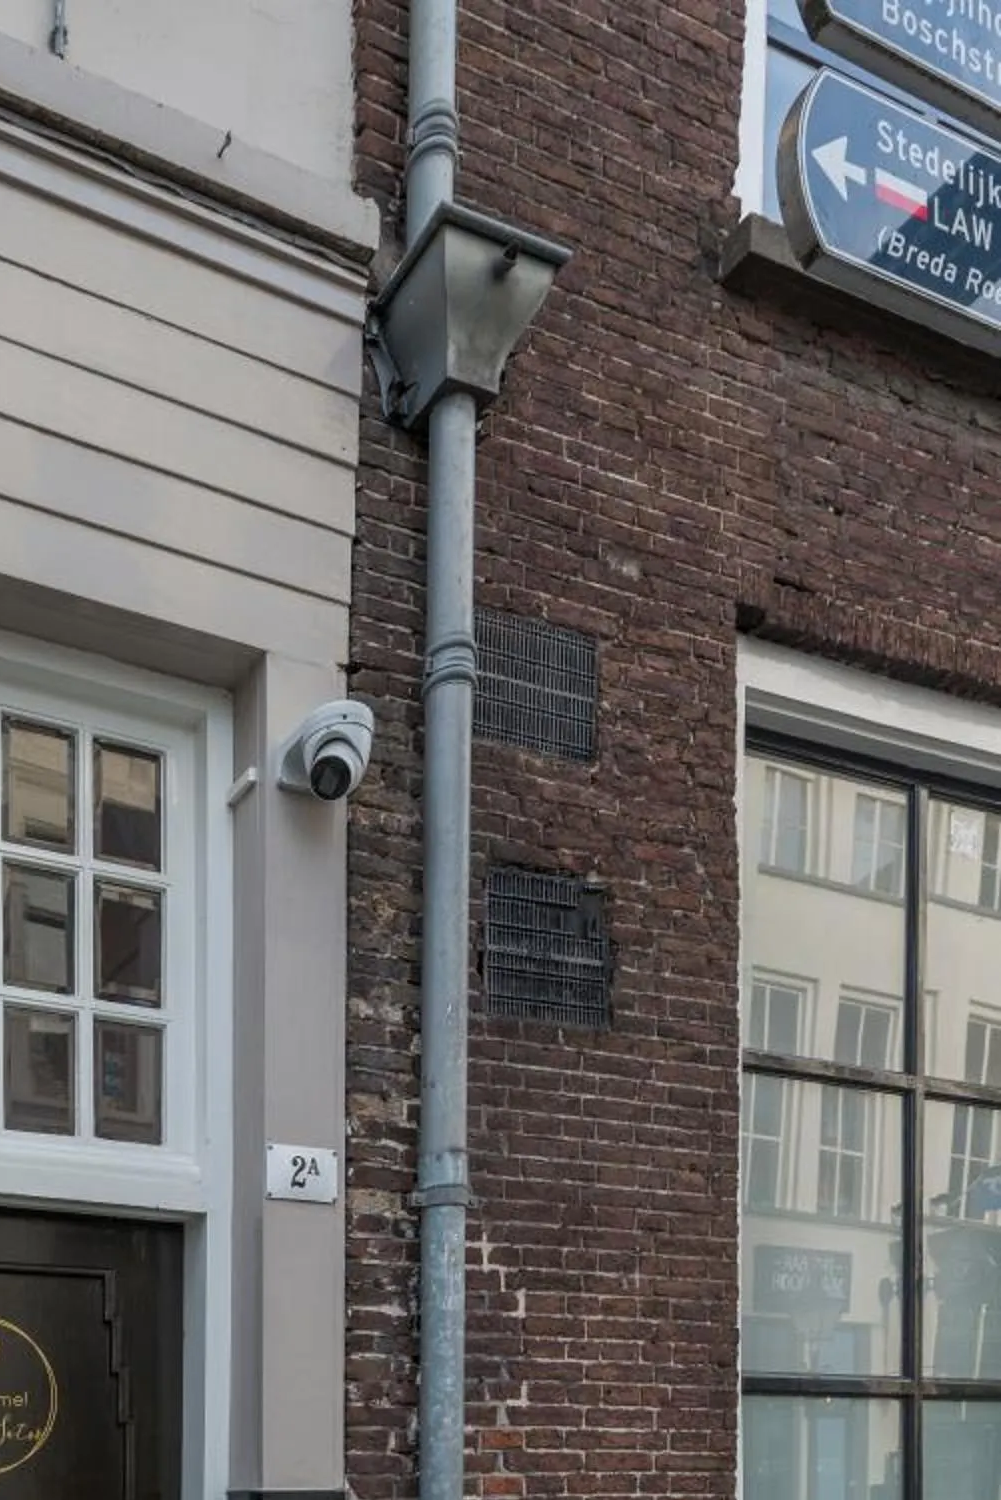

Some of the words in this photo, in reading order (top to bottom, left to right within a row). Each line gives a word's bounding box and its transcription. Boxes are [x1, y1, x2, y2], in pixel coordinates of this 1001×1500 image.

[882, 0, 1001, 87] Boschst
[934, 196, 993, 251] LAW
[878, 225, 958, 284] (Breda
[291, 1155, 320, 1188] 2A
